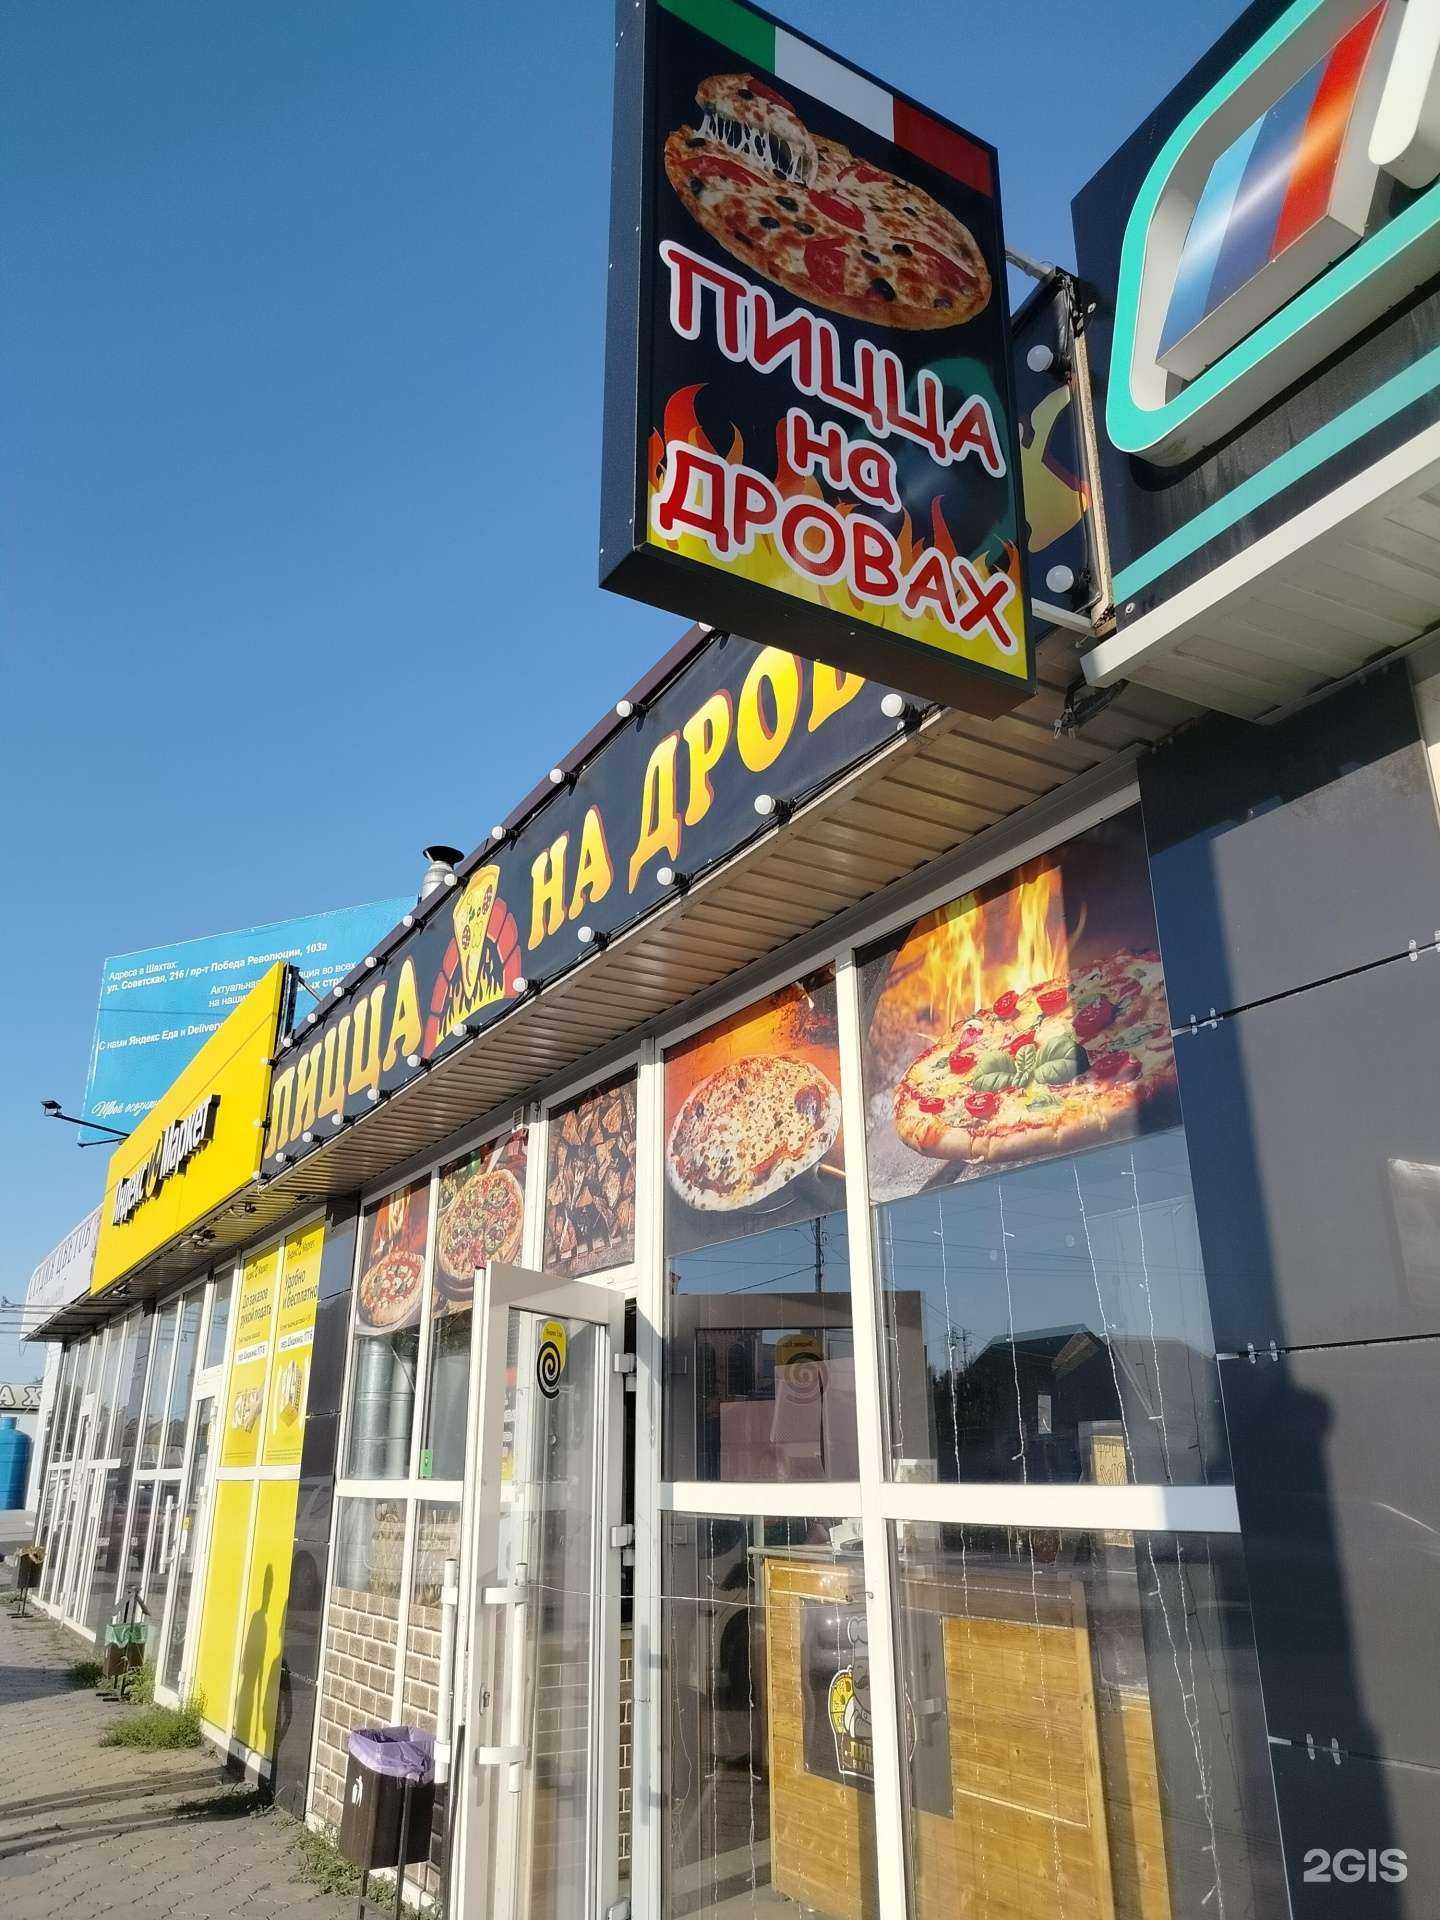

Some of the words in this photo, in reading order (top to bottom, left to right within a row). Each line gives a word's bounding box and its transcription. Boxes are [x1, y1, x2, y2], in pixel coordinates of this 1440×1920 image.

[661, 241, 1006, 476] ПИЦЦА
[788, 409, 899, 508] на
[650, 442, 1017, 655] ДРОВАХ
[109, 969, 137, 981] Адреса
[139, 967, 145, 975] в
[121, 976, 167, 990] Советская,
[210, 958, 246, 972] Победа
[247, 949, 303, 966] Революции,
[208, 1000, 220, 1008] на
[264, 957, 423, 1160] ПИЦЦА
[528, 804, 614, 950] НА
[99, 1041, 106, 1050] С
[107, 1040, 127, 1049] нами
[128, 1034, 160, 1046] Яндекс
[161, 1030, 178, 1040] Еда
[159, 1094, 217, 1176] Маркет
